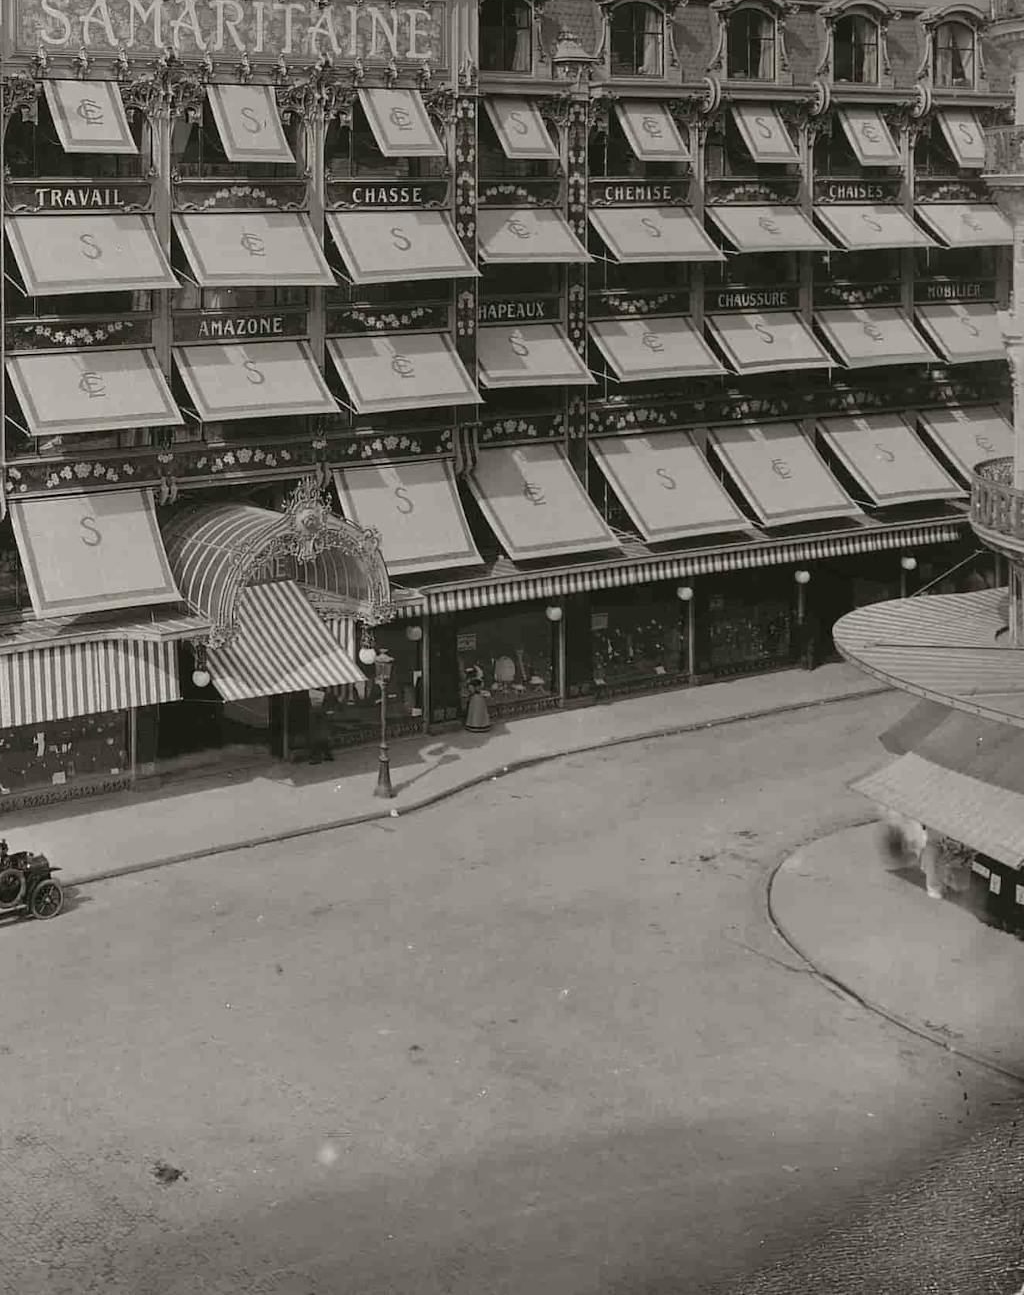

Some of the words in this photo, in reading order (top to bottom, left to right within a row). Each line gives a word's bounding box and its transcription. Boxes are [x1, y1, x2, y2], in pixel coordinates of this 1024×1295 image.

[34, 186, 126, 208] TRAVAIL
[351, 185, 423, 207] CHASSE
[605, 183, 672, 202] CHEMISE
[828, 182, 884, 200] CHAISES
[718, 291, 789, 309] CHAUSSURE
[478, 301, 545, 320] HAPEAUX
[199, 316, 285, 337] AMAZONE
